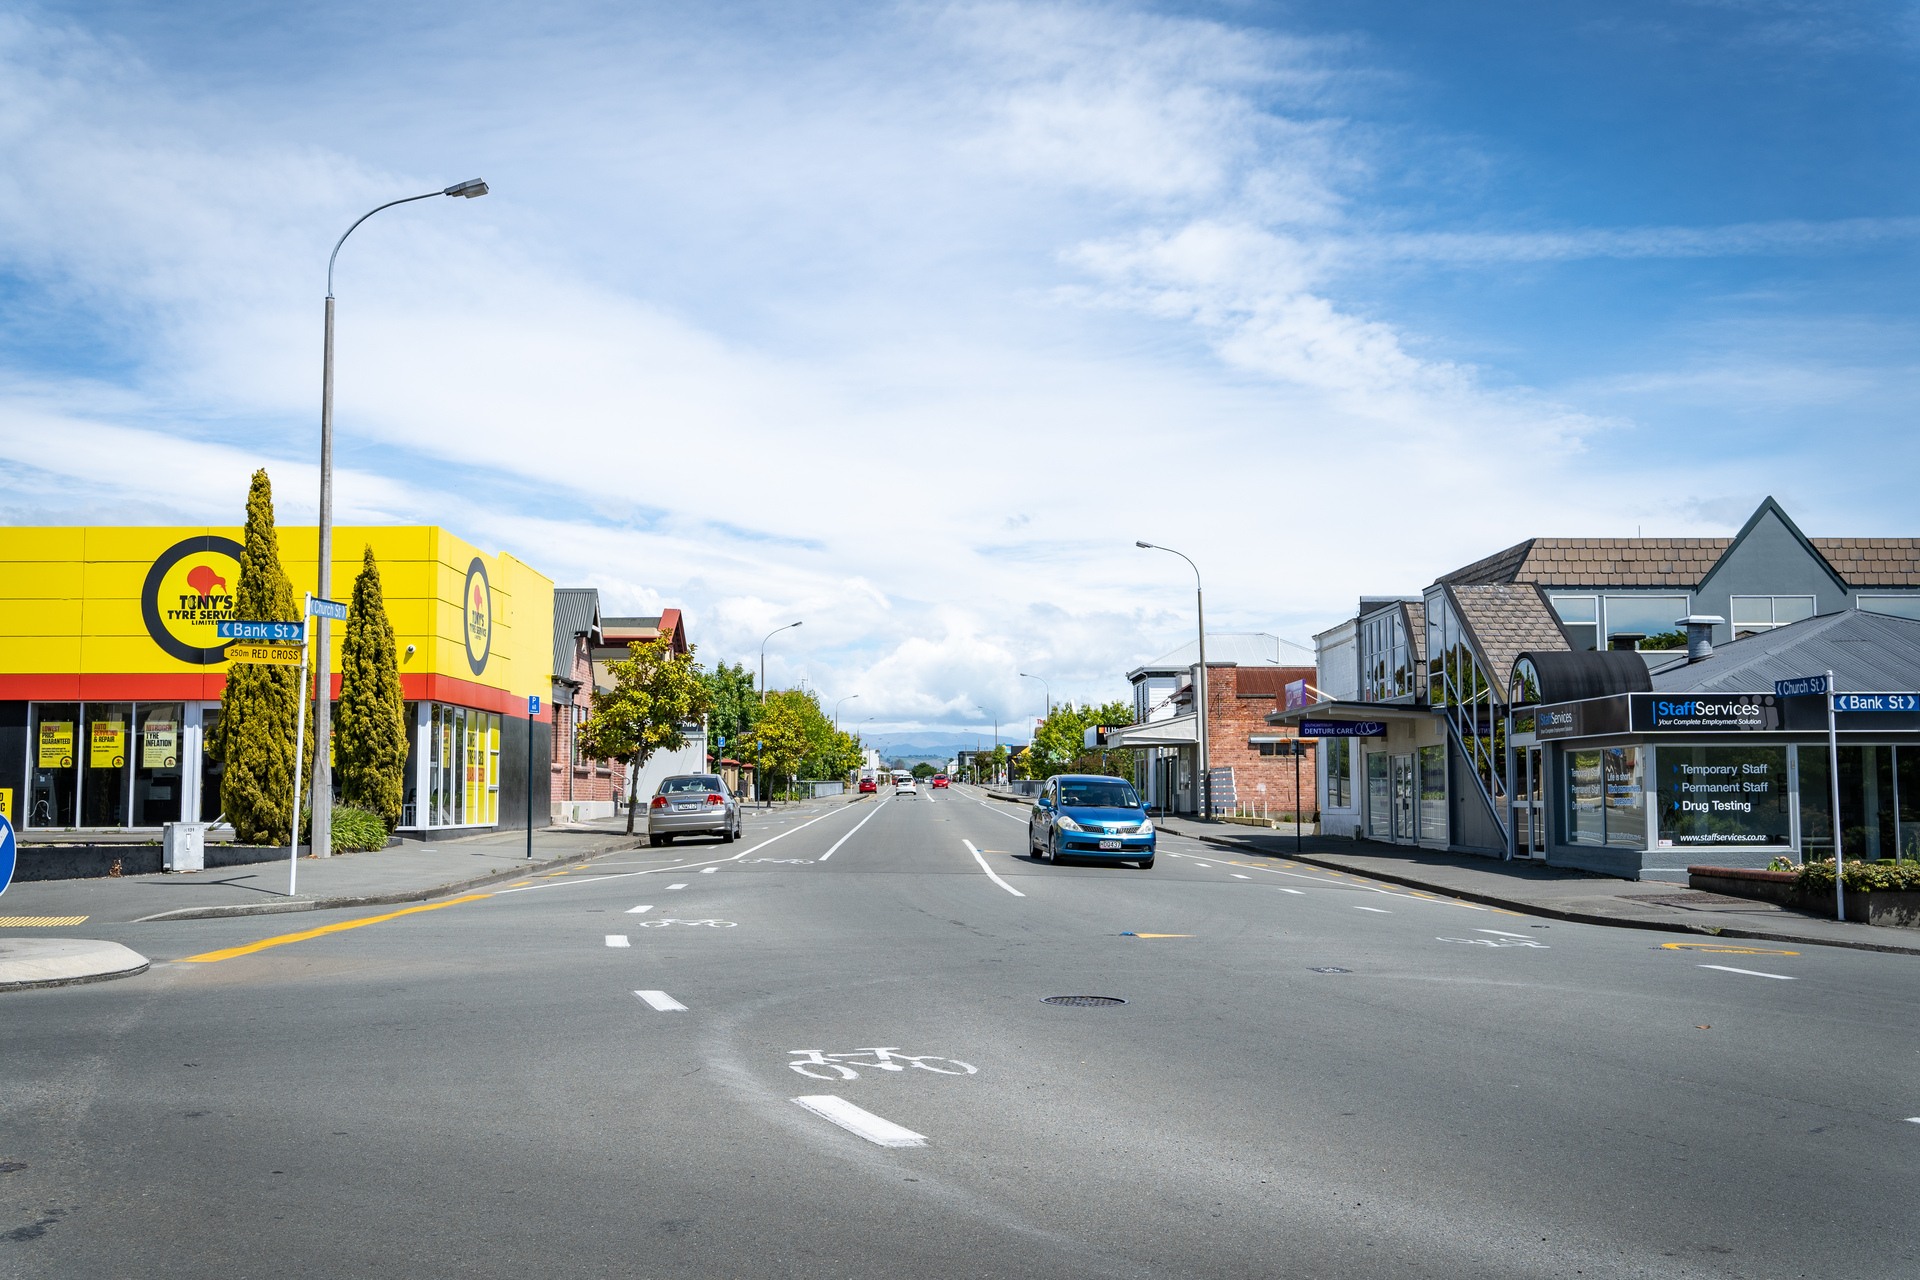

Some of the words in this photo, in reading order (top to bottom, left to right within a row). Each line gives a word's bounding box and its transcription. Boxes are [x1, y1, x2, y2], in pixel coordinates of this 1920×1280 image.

[180, 595, 233, 610] TONY'S
[314, 600, 334, 615] Church
[334, 604, 342, 617] St
[167, 610, 196, 620] TYRE
[200, 610, 236, 620] SERVI
[233, 623, 268, 637] Bank
[274, 624, 288, 638] St
[230, 649, 249, 657] 250m
[251, 649, 268, 659] RED
[271, 649, 299, 660] CROSS
[1782, 680, 1808, 695] Church
[1810, 678, 1820, 692] St
[1658, 701, 1760, 716] StaffServices
[1850, 695, 1883, 709] Bank
[1888, 695, 1904, 709] St
[146, 739, 172, 747] INFLATION
[1680, 764, 1738, 776] Temporary
[1742, 763, 1768, 774] Staff
[1681, 782, 1740, 792] Permanent
[1742, 781, 1768, 792] Staff
[1682, 800, 1709, 812] Drug
[1712, 800, 1751, 812] Testing
[1680, 833, 1767, 842] www.staffservices.co.nz
